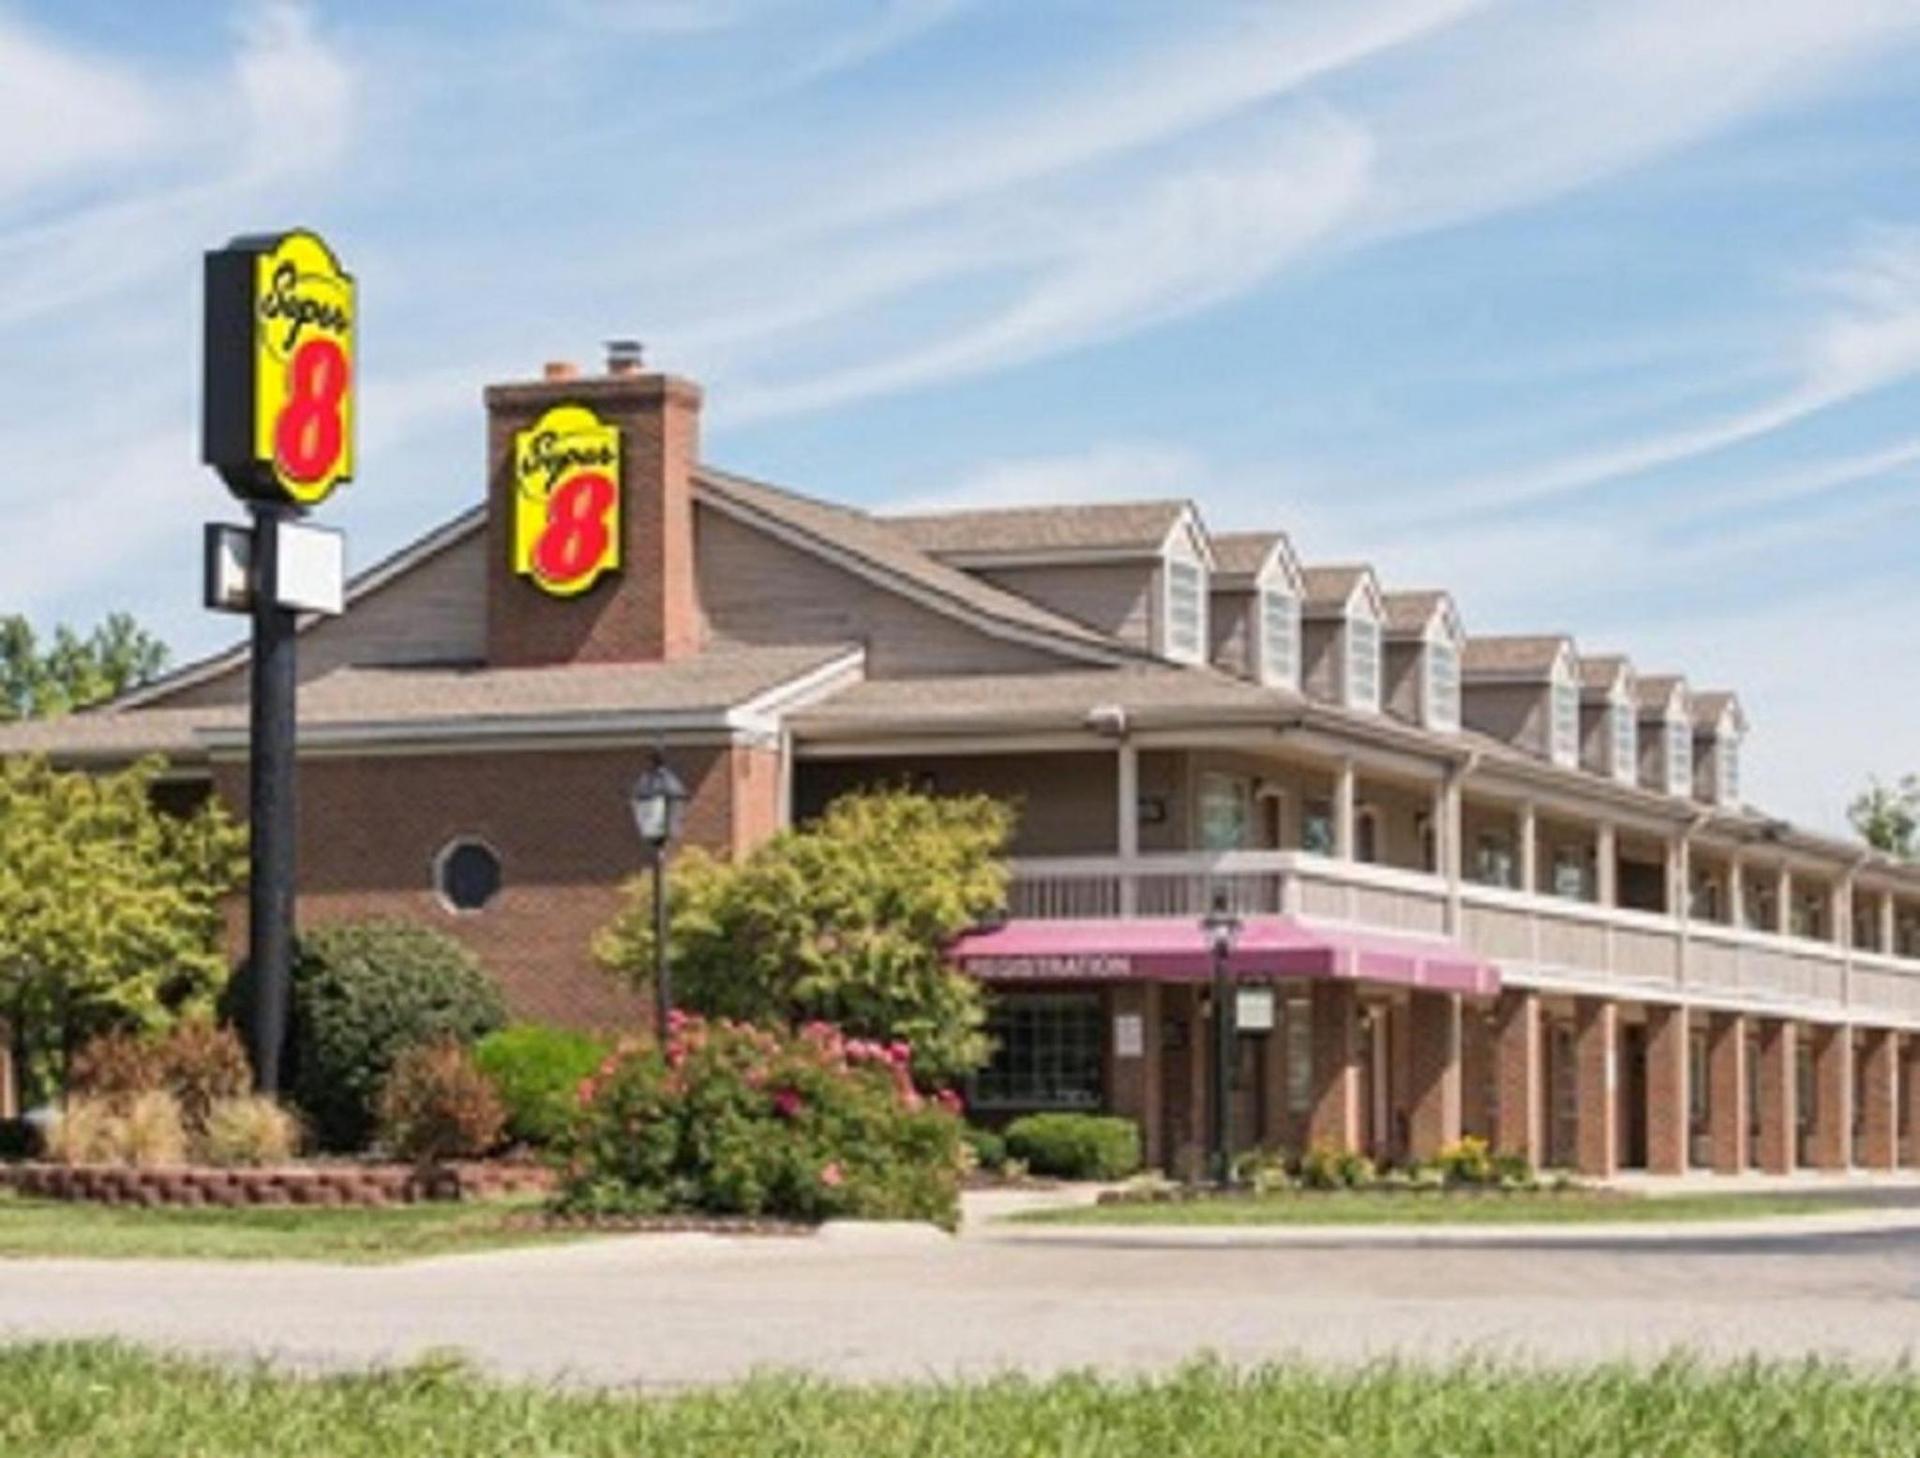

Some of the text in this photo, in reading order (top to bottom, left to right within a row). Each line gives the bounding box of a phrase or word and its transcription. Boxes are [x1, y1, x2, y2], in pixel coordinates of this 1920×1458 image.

[260, 261, 348, 351] Super
[275, 338, 350, 483] 8
[521, 431, 616, 493] Super
[532, 471, 617, 583] 8
